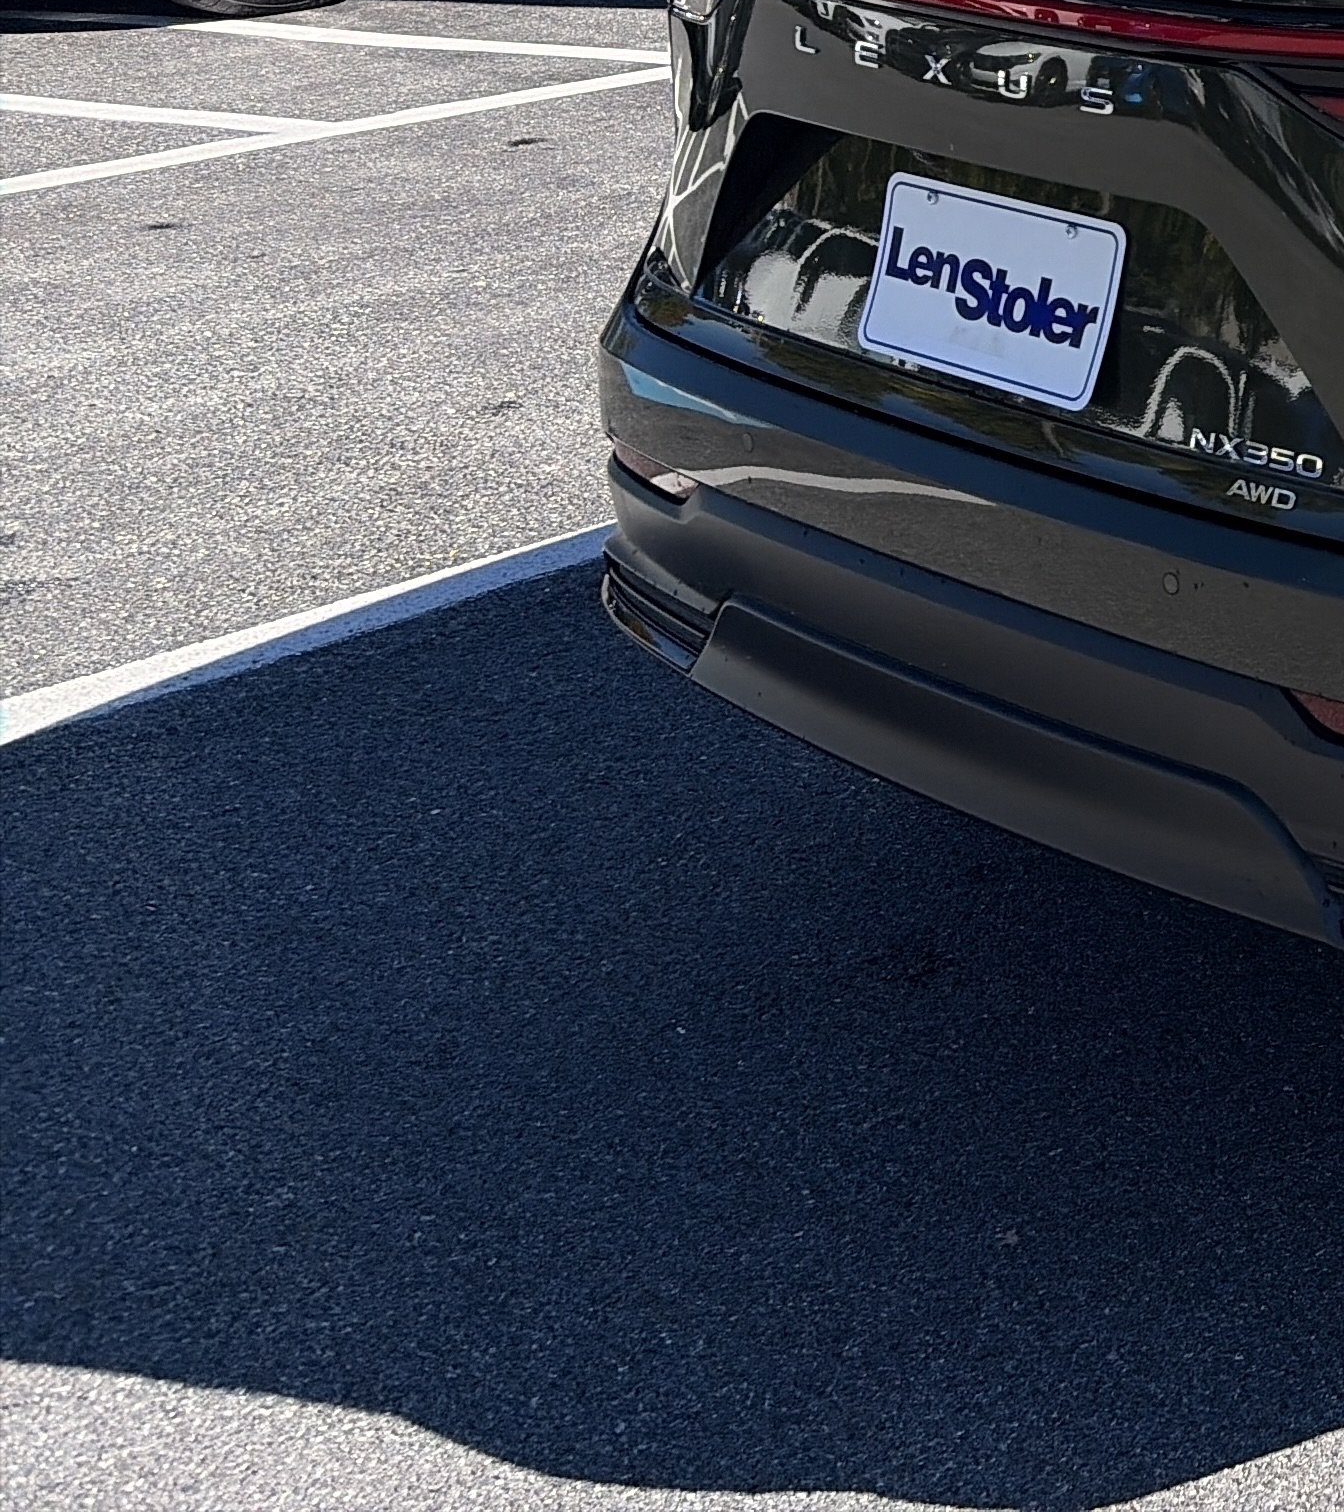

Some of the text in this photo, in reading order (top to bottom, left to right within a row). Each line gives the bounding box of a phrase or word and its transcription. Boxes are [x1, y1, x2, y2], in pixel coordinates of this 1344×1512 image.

[794, 25, 1114, 116] LEXUS
[1189, 428, 1323, 479] NX350
[1226, 478, 1297, 510] AWD
